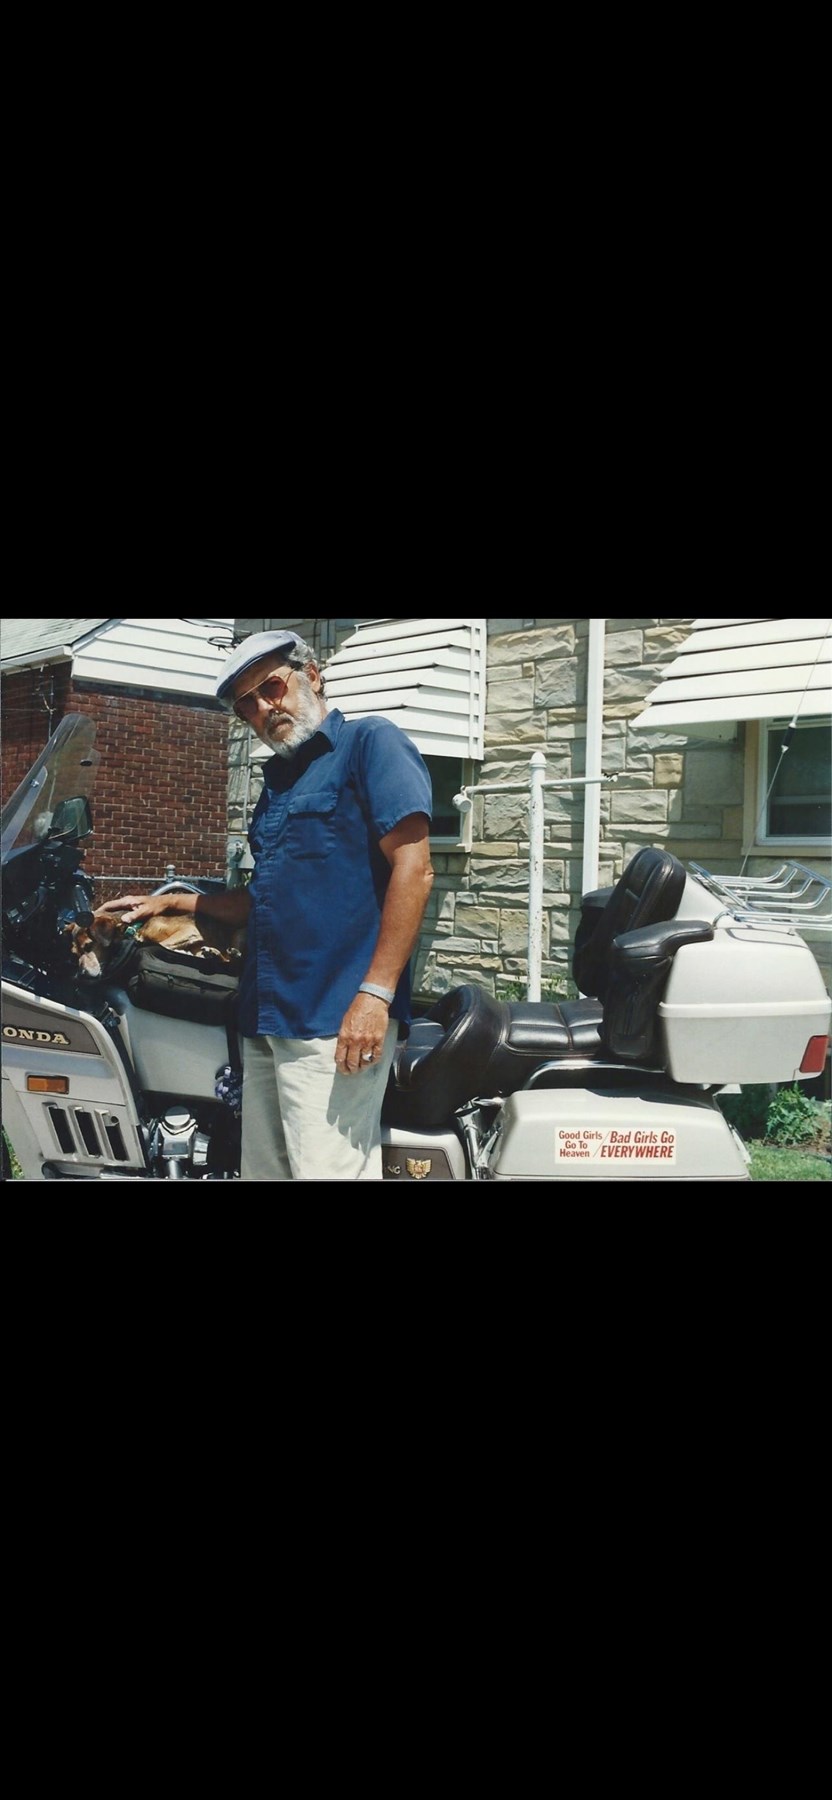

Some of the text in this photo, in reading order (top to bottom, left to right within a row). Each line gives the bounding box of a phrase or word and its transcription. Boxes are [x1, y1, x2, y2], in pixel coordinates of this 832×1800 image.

[1, 1026, 70, 1045] ONDA
[559, 1130, 602, 1140] Good Girls
[610, 1131, 674, 1143] Bad Girls Go
[565, 1140, 588, 1149] Go To
[559, 1149, 590, 1158] Heaven
[600, 1145, 674, 1158] EVERYWHERE
